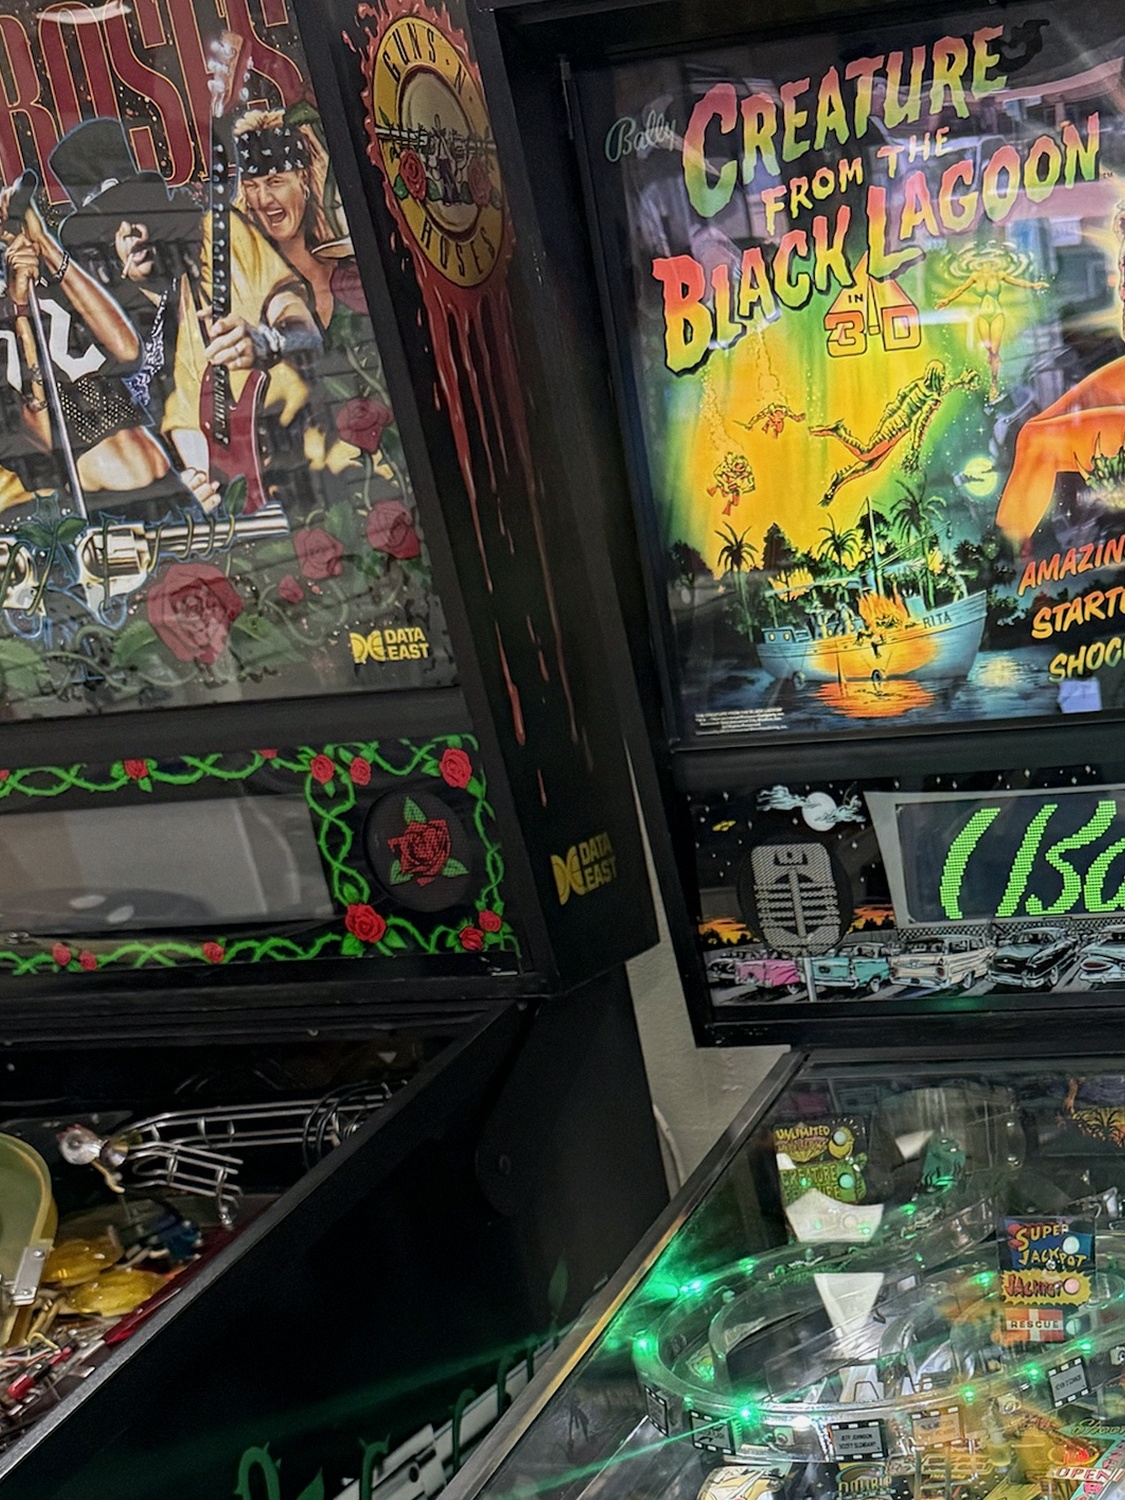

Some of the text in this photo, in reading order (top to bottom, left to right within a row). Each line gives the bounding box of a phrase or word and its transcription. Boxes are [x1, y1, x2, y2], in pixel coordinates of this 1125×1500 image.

[382, 22, 437, 85] GUNS
[604, 109, 678, 163] Bally
[682, 25, 1008, 218] CREATURE
[760, 126, 951, 237] FROM THE
[652, 111, 1100, 376] BLACK LAGOON
[847, 293, 864, 303] IN
[384, 626, 427, 644] DATA
[922, 610, 953, 630] RITA
[386, 643, 430, 661] EAST
[579, 832, 613, 866] DATA
[584, 856, 617, 891] EAST
[1016, 1223, 1069, 1252] SUPER
[1018, 1247, 1087, 1267] JACKPOT
[1010, 1320, 1060, 1329] RESCUE
